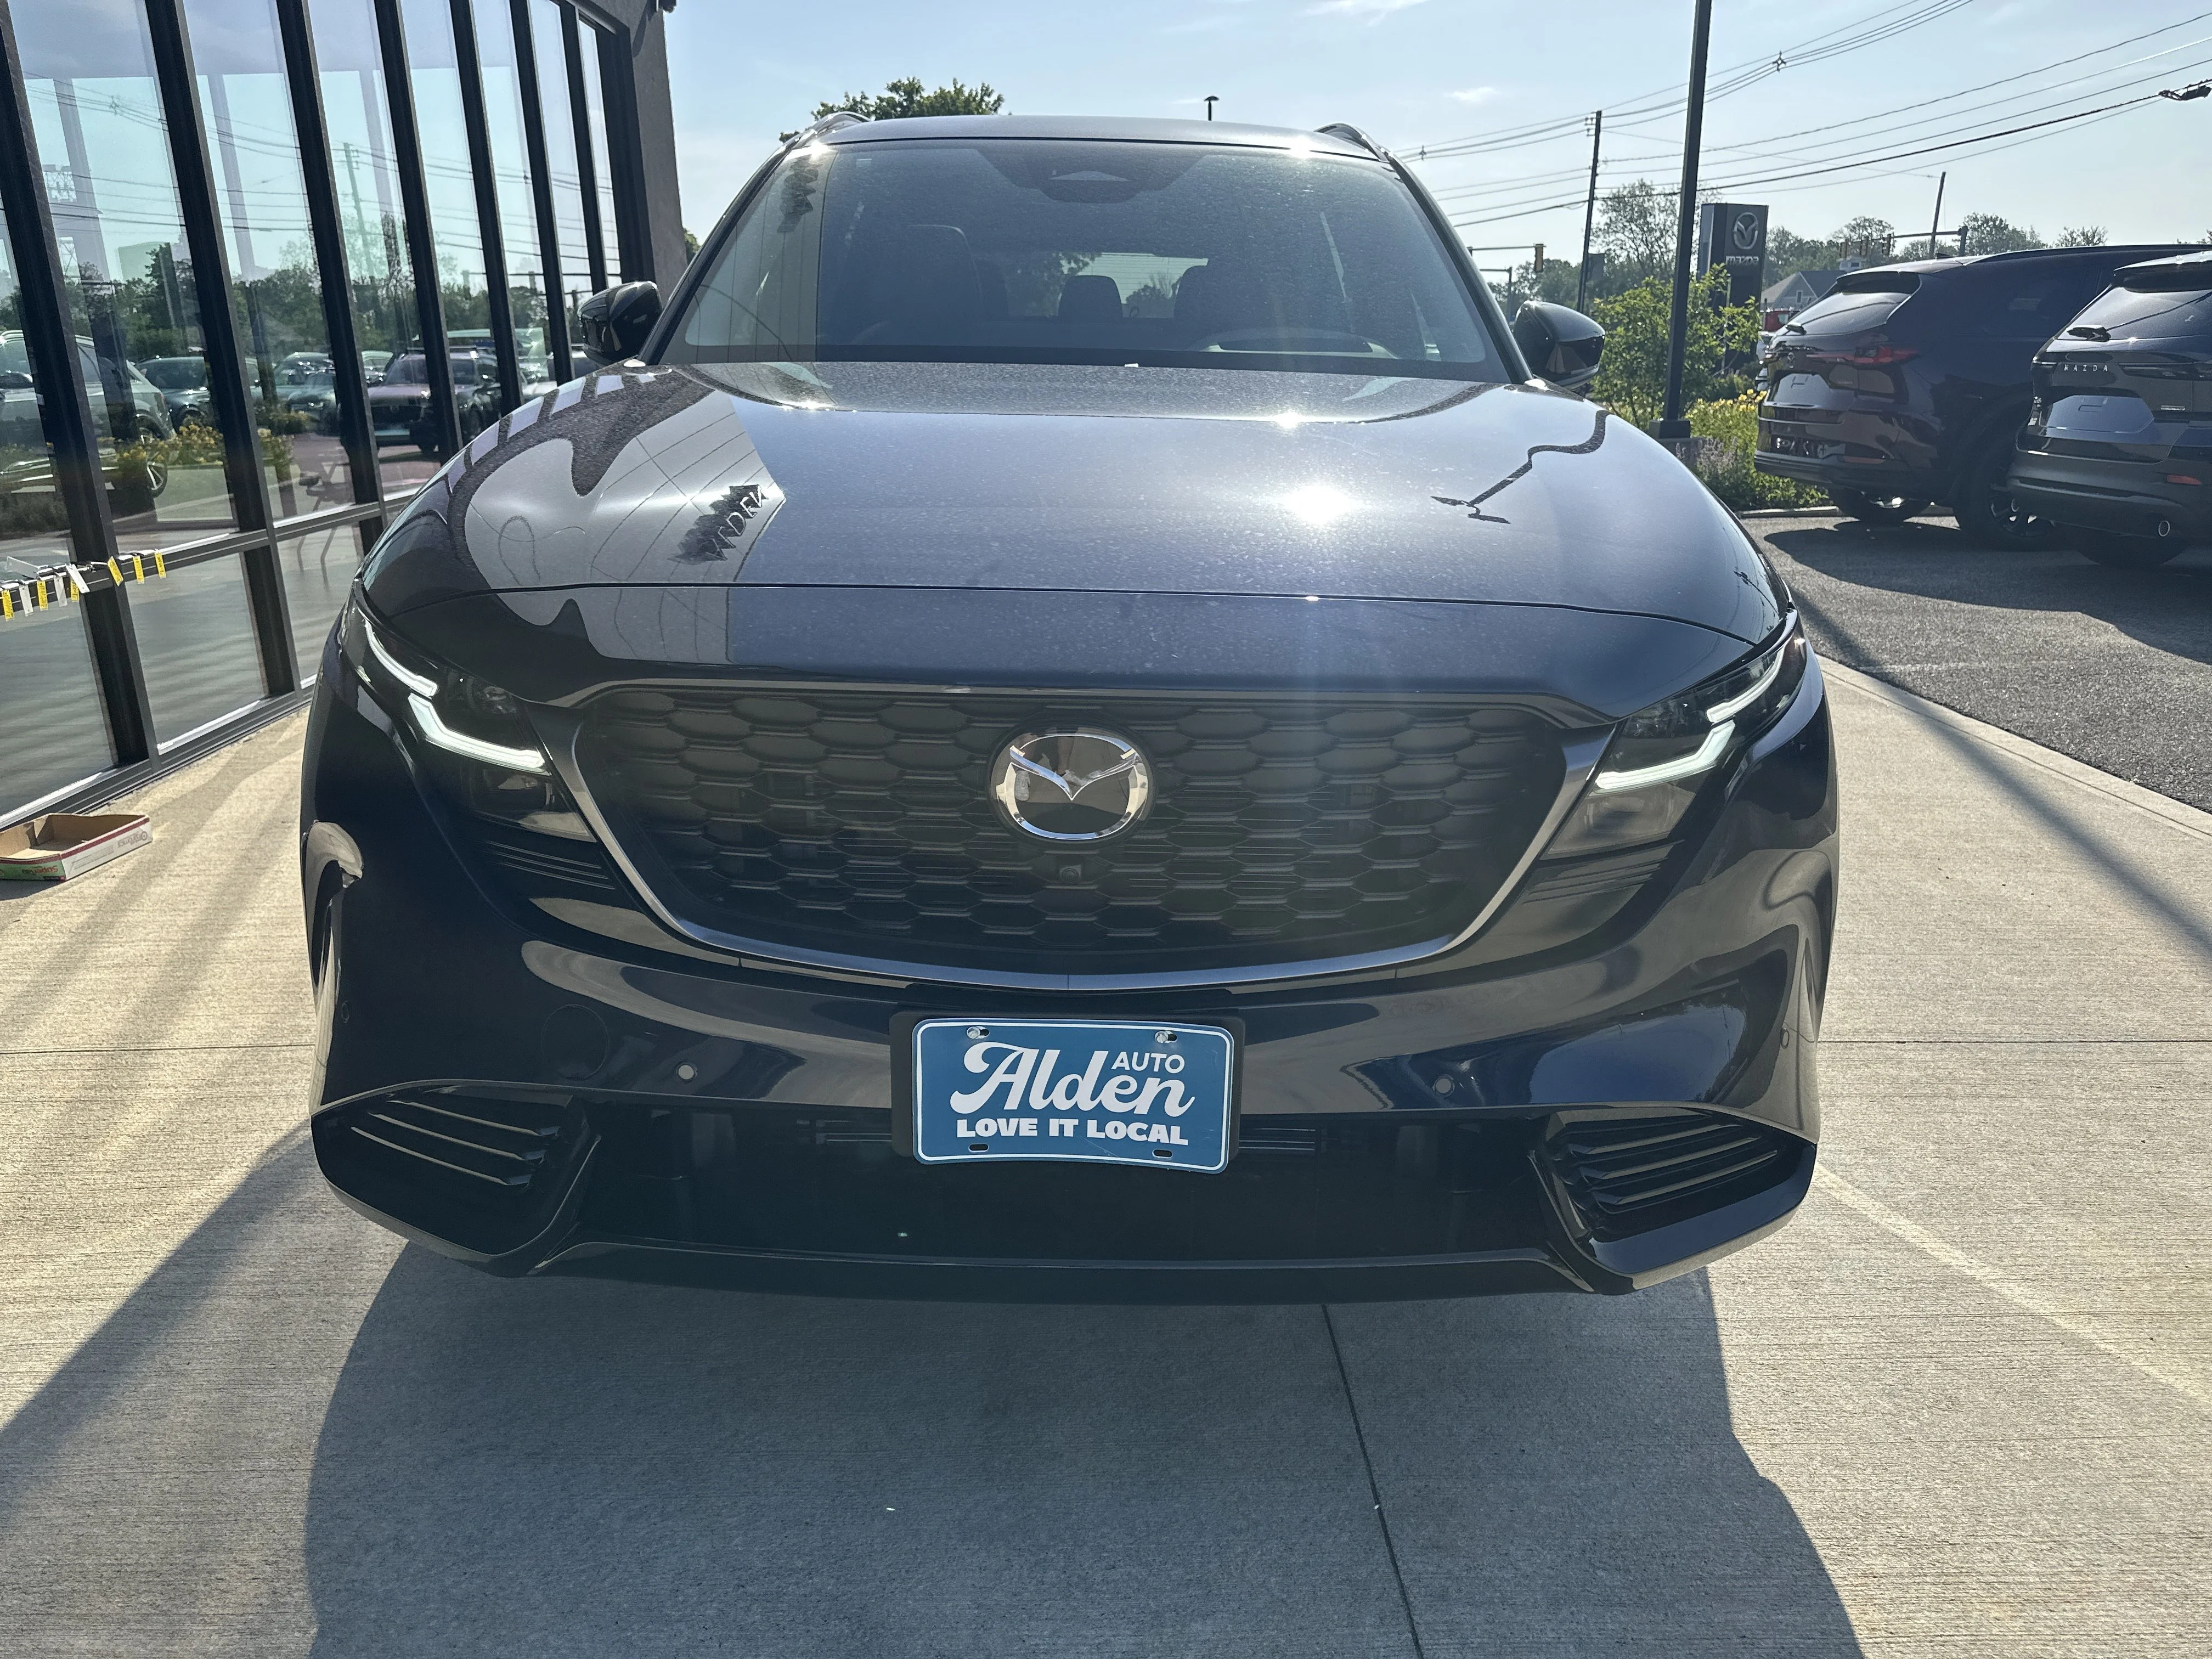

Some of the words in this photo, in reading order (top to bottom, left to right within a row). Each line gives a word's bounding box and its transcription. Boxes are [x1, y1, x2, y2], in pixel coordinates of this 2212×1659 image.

[2064, 364, 2108, 372] MAZDA
[1111, 1051, 1185, 1074] AUTO
[950, 1041, 1195, 1118] Alden
[957, 1118, 1038, 1138] LOVE
[1048, 1119, 1079, 1137] IT
[1086, 1119, 1188, 1146] LOCAL
